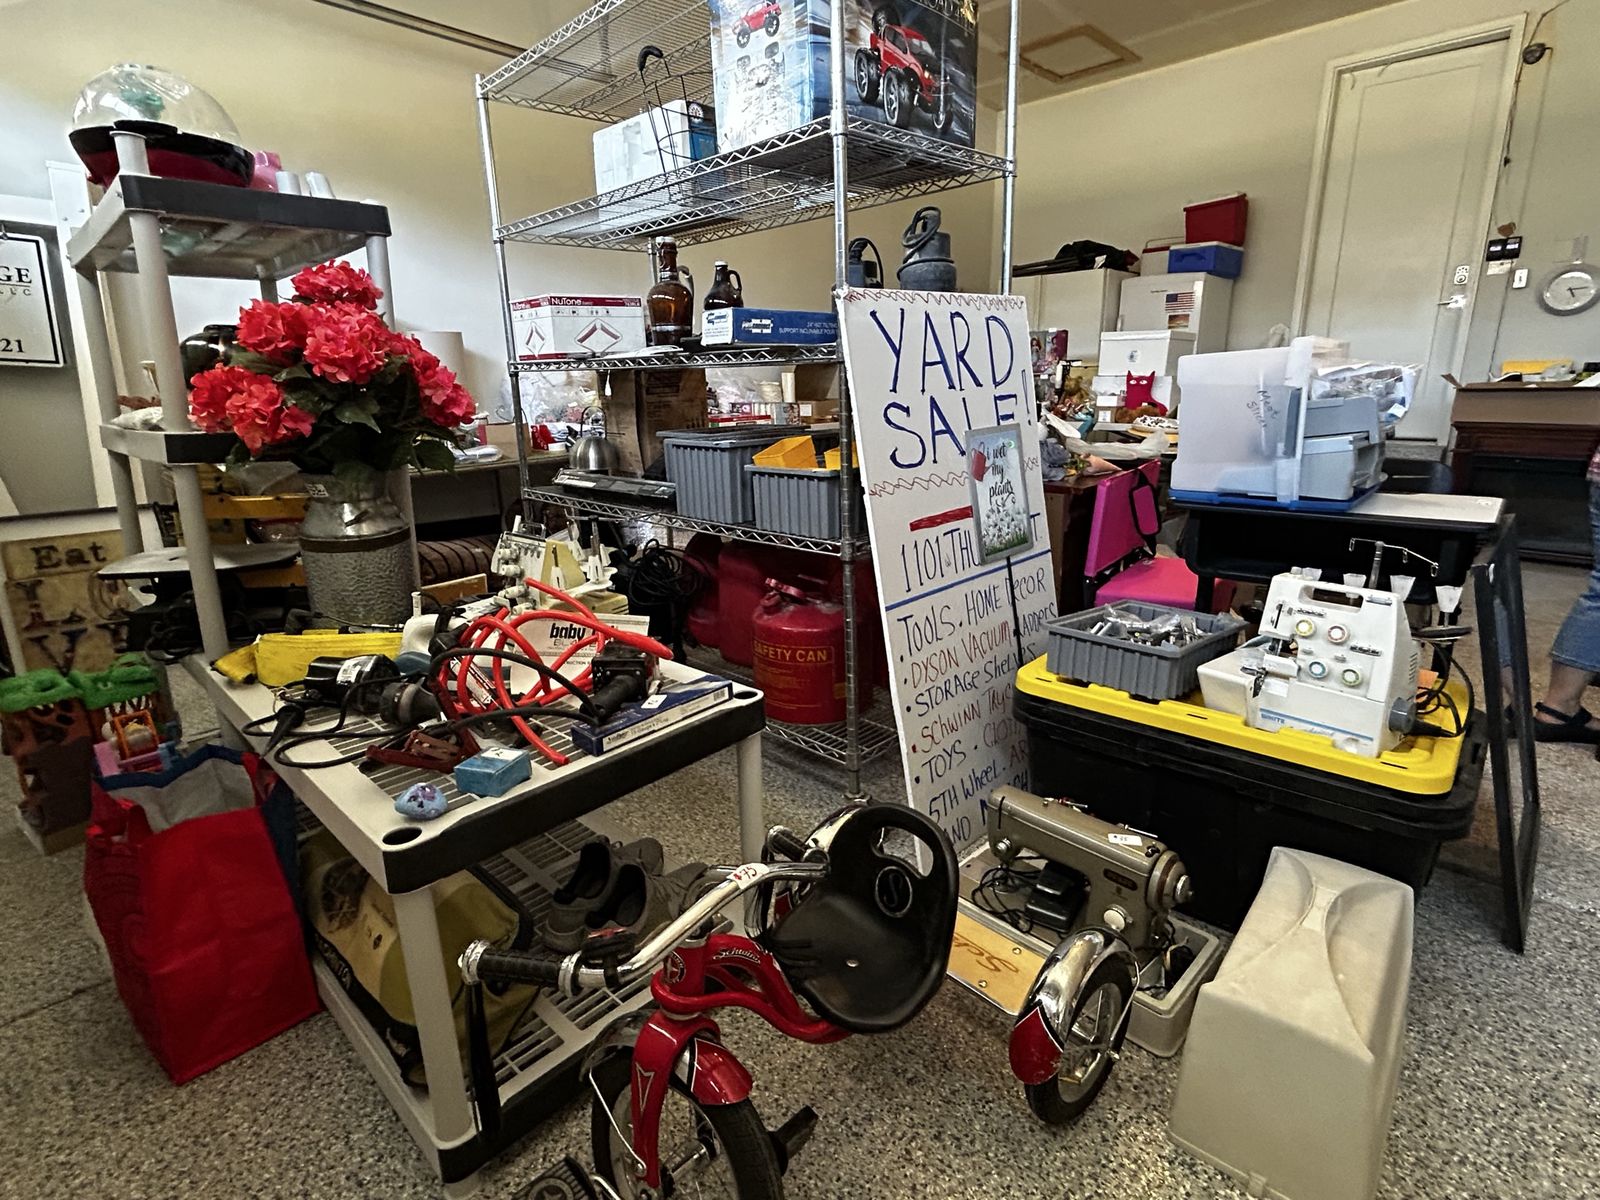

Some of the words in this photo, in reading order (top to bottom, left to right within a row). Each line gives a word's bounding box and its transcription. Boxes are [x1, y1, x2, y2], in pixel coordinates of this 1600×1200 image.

[551, 297, 582, 306] NuTone
[870, 308, 1014, 394] YARD
[992, 442, 1007, 459] wet
[991, 463, 1004, 484] my
[989, 479, 1014, 506] plants
[30, 541, 107, 570] Eat
[901, 535, 944, 593] 1101
[549, 622, 586, 644] baby
[897, 604, 956, 656] TOOLS
[965, 584, 1003, 627] HOME
[753, 639, 792, 661] SAFETY
[795, 649, 827, 662] CAN
[911, 646, 959, 689] DYSON
[921, 739, 967, 784] TOYS
[929, 785, 959, 825] 5TH
[712, 947, 761, 965] Schwinn
